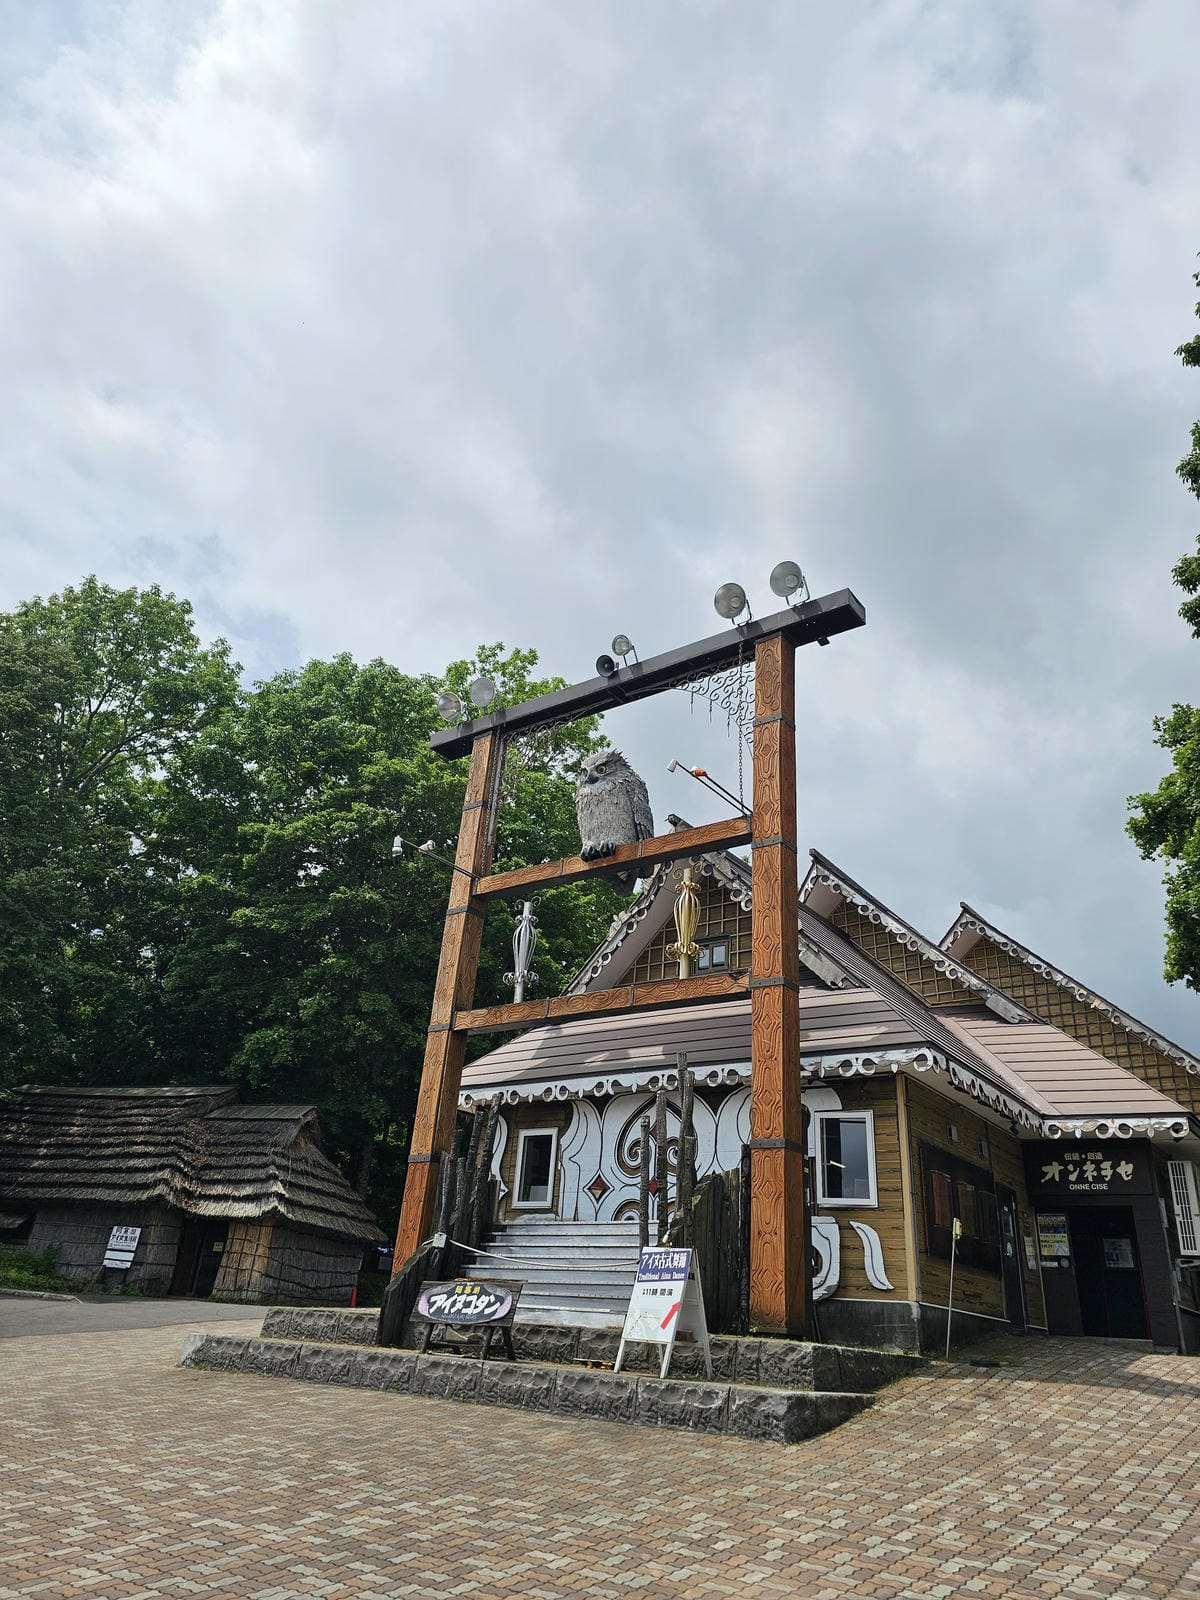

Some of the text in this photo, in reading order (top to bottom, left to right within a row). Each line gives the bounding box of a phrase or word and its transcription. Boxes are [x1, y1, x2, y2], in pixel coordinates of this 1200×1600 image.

[1041, 1161, 1134, 1182] オンネチセ
[429, 1293, 501, 1315] アイヌコタン
